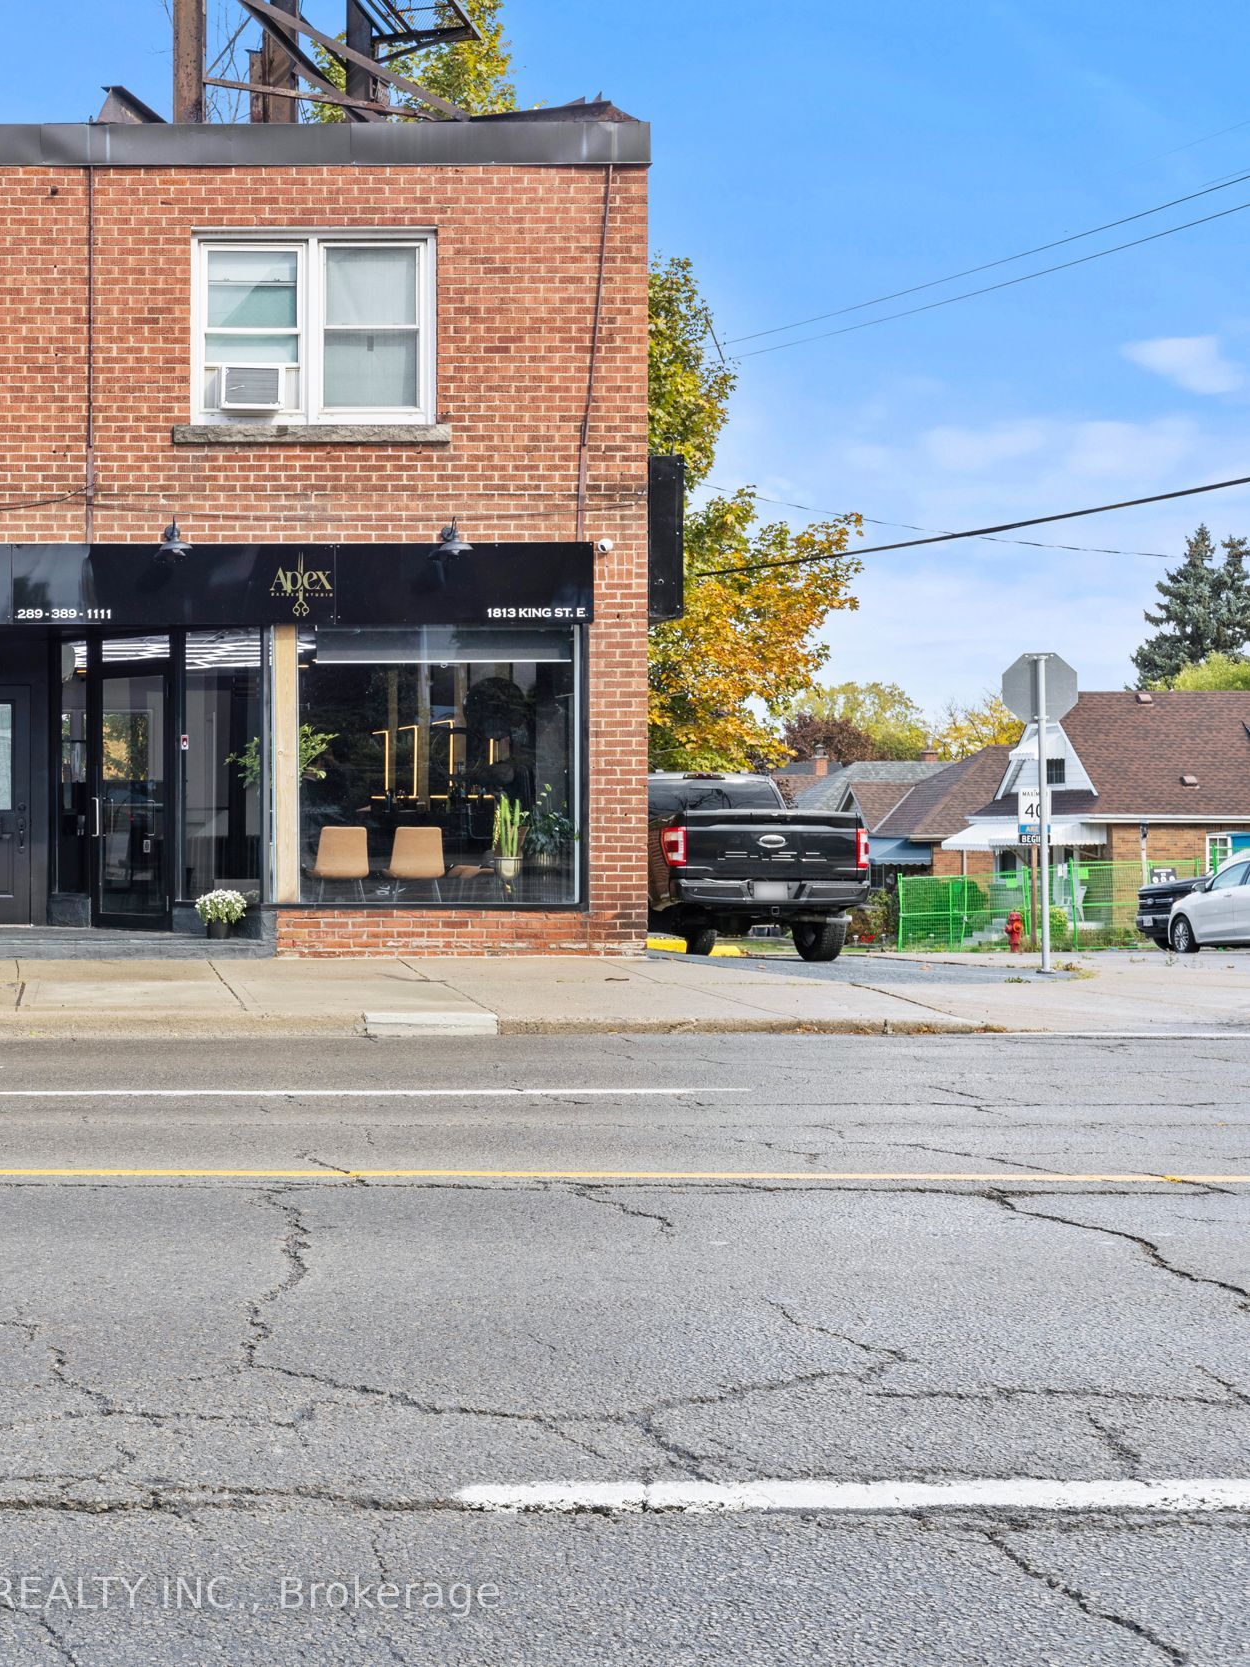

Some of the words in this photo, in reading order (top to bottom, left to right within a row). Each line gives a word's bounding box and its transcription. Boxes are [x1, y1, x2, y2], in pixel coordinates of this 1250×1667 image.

[269, 566, 333, 593] Apex
[487, 607, 516, 618] 1813
[518, 607, 552, 618] KING
[554, 607, 573, 618] ST.
[1021, 835, 1041, 843] BEGI
